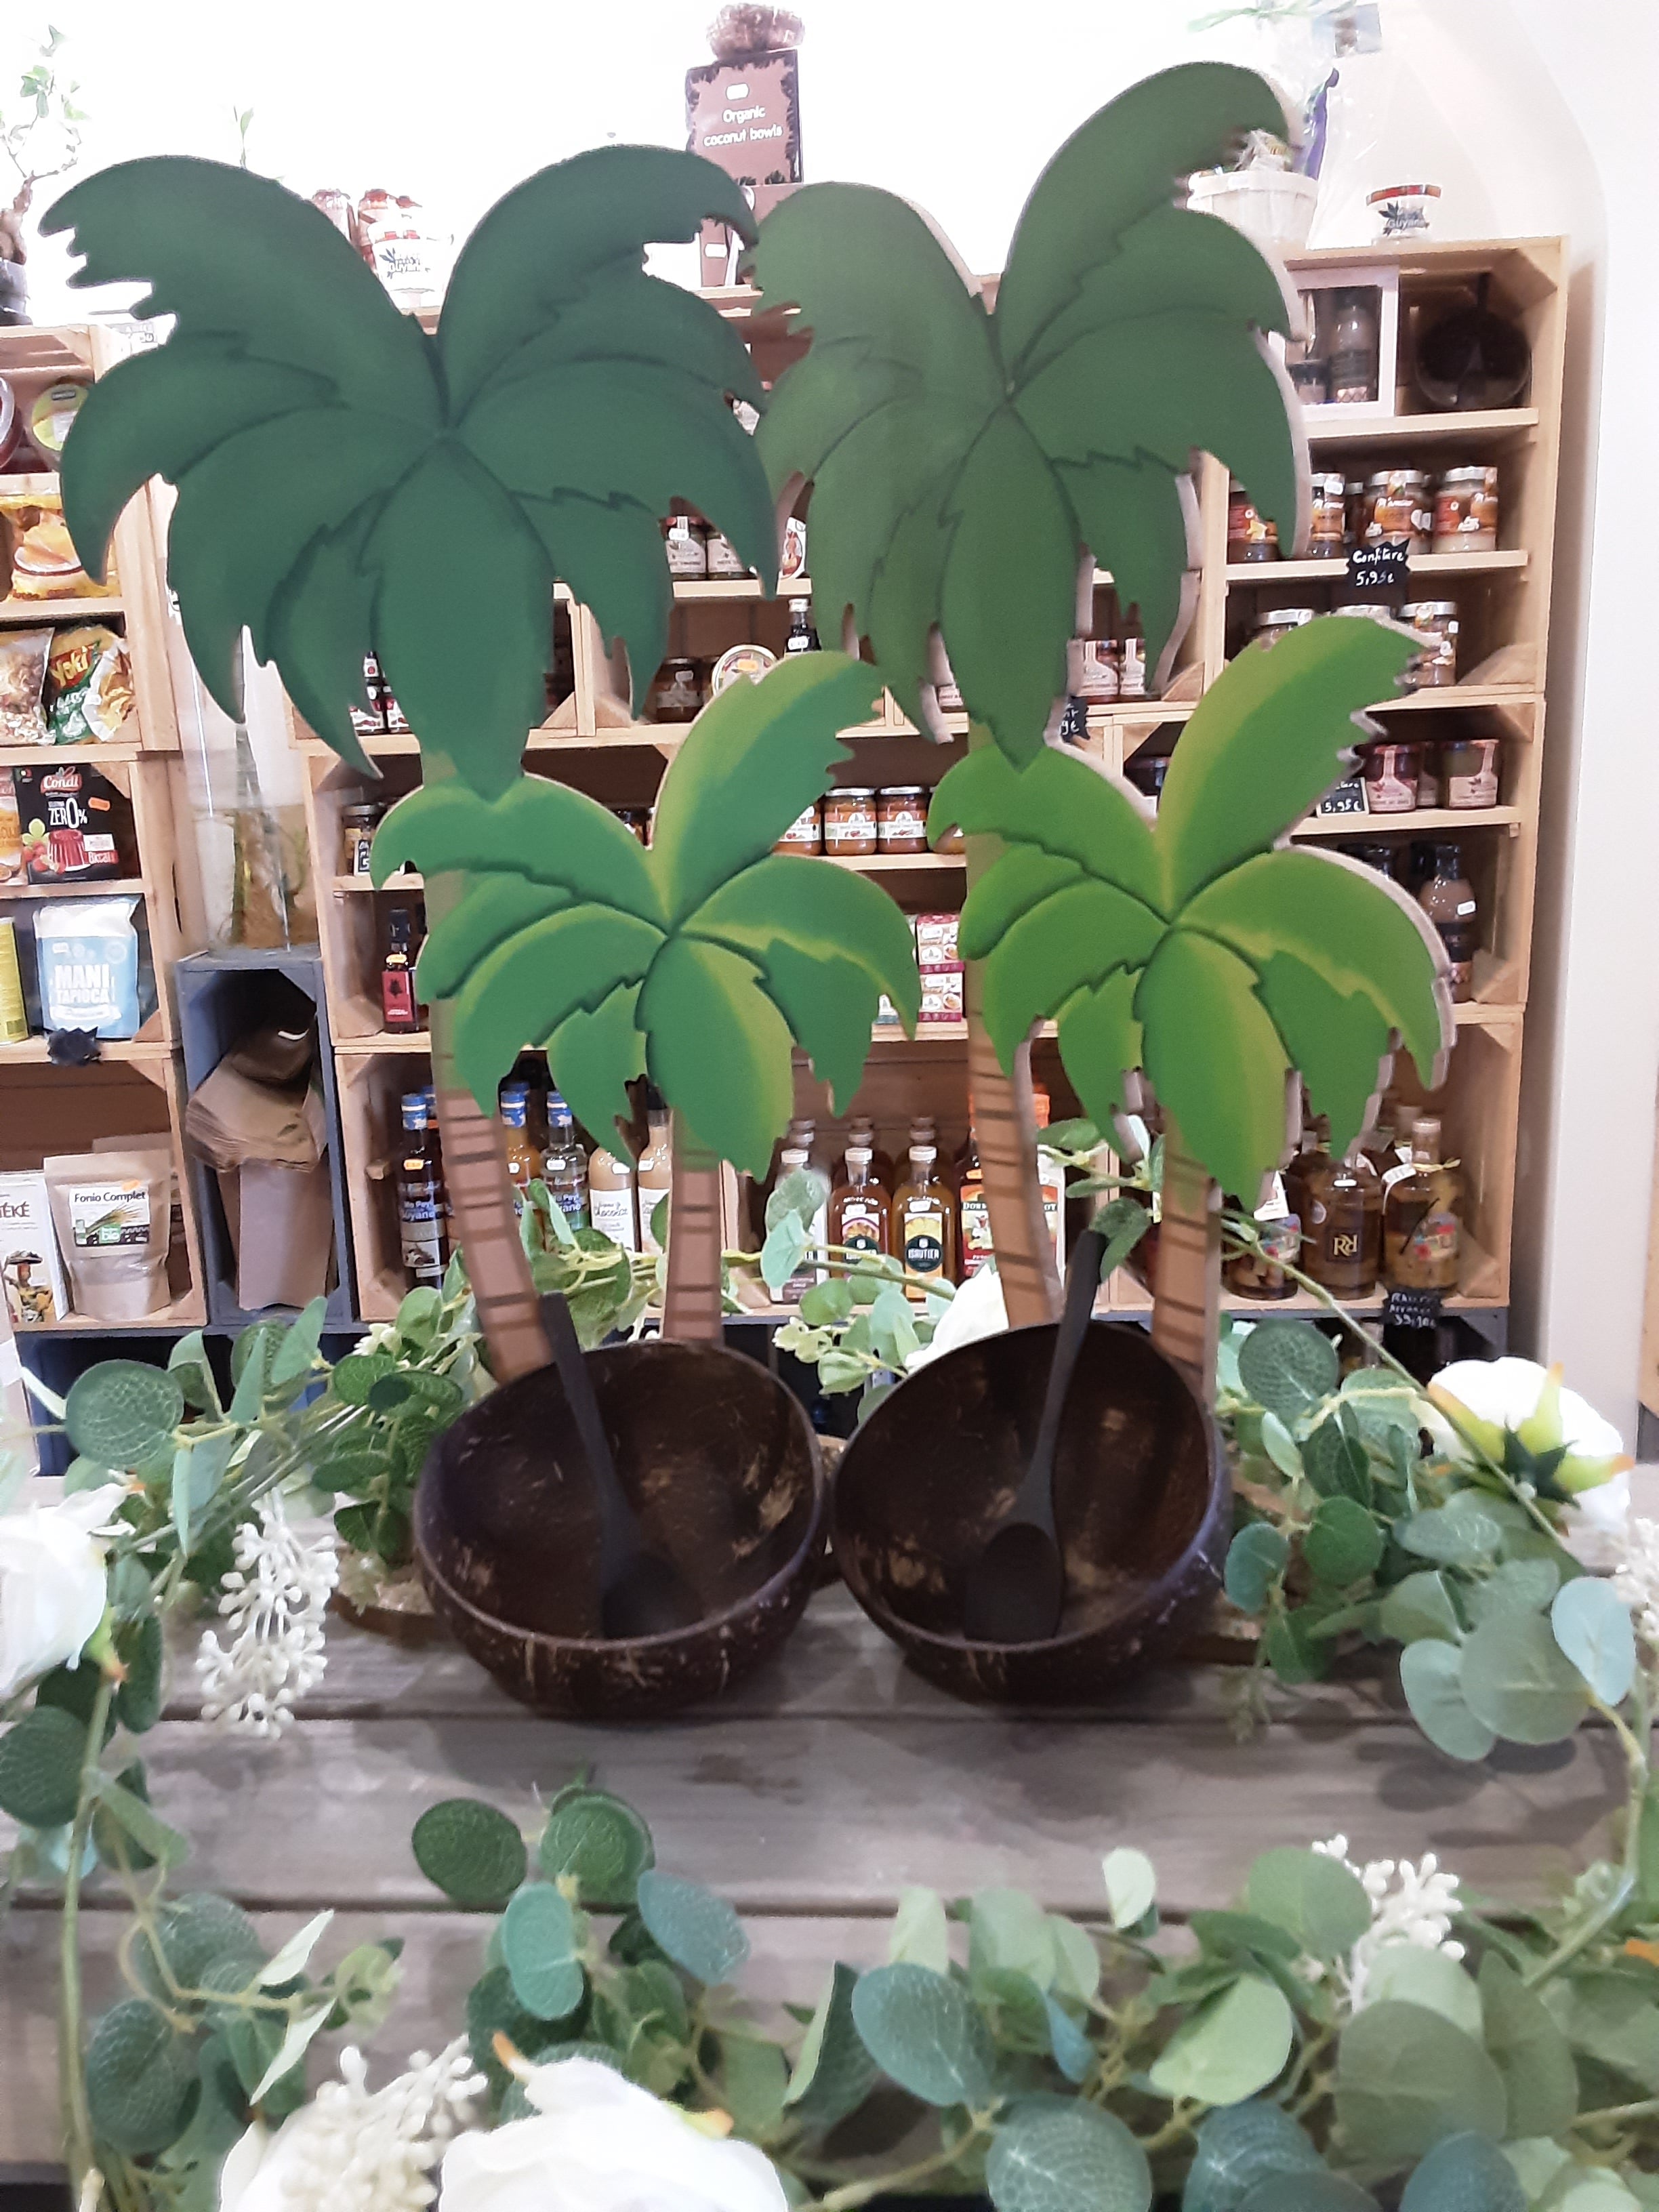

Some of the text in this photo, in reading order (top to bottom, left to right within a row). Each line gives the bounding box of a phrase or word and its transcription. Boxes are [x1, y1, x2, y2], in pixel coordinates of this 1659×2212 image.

[723, 105, 766, 124] Organic
[703, 124, 783, 147] coconut bowls
[51, 646, 89, 689] Yoki
[56, 963, 110, 989] MANI
[56, 989, 110, 1004] TAPIOCA
[75, 1191, 146, 1203] Fonio Complet
